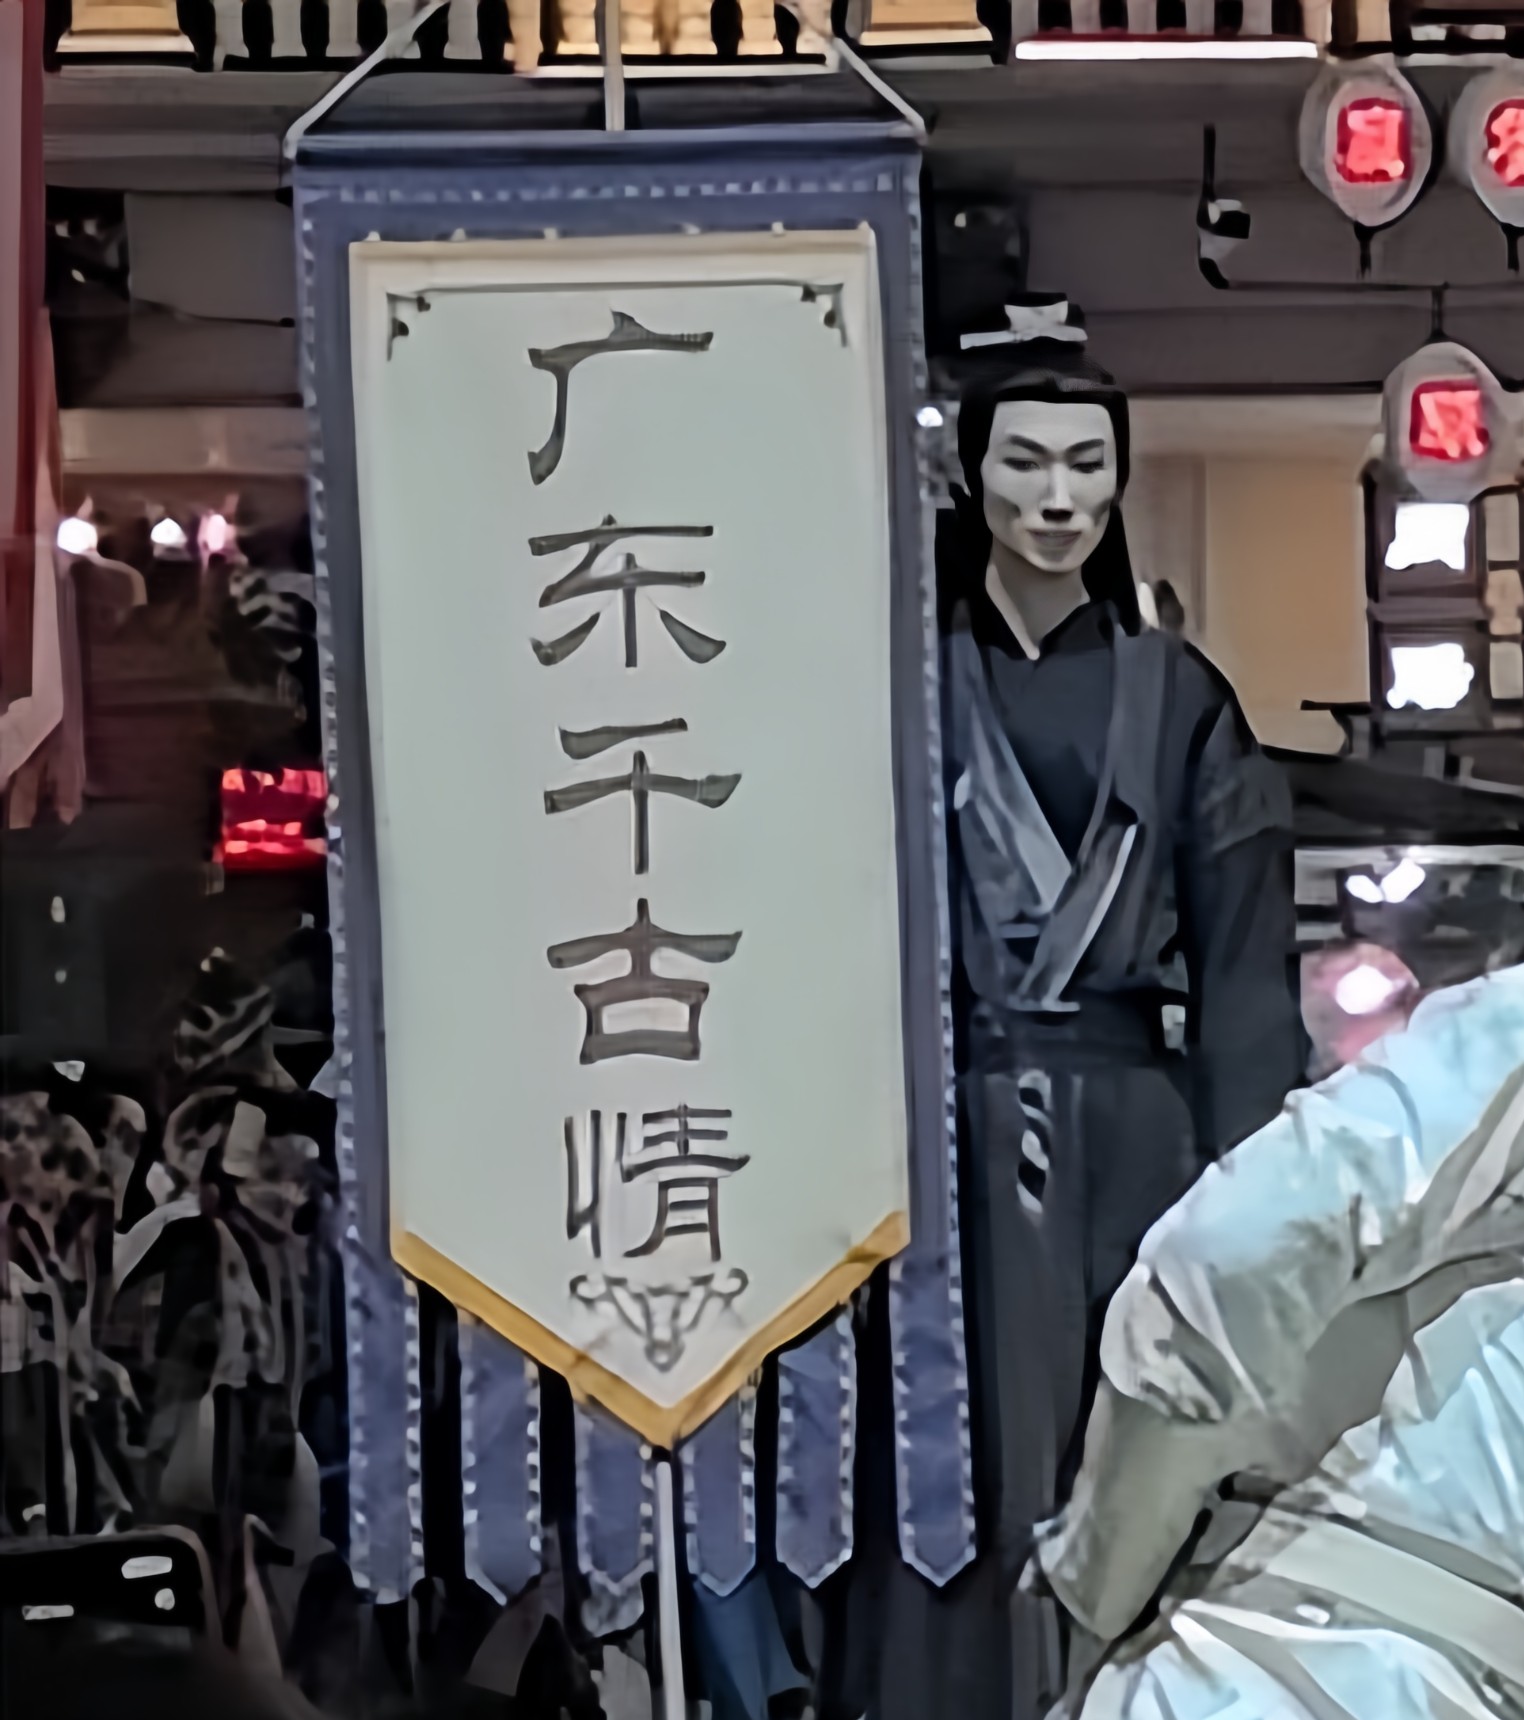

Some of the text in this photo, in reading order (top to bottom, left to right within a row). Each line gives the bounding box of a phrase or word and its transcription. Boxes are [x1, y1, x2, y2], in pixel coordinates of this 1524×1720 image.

[527, 309, 751, 1263] 广东千古情
